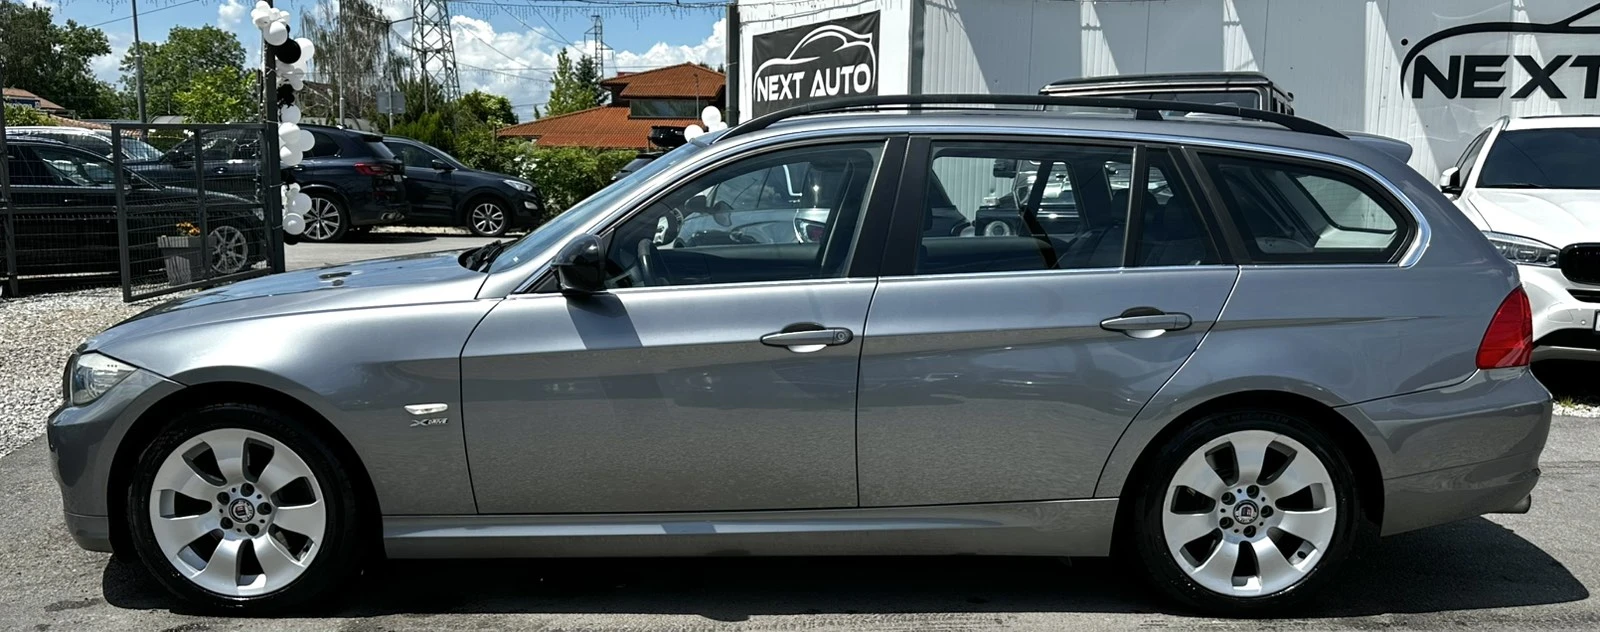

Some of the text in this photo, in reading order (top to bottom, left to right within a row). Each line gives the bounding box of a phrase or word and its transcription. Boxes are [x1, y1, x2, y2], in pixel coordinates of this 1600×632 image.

[757, 63, 871, 102] NEXT AUTO
[1412, 55, 1600, 99] NEXT
